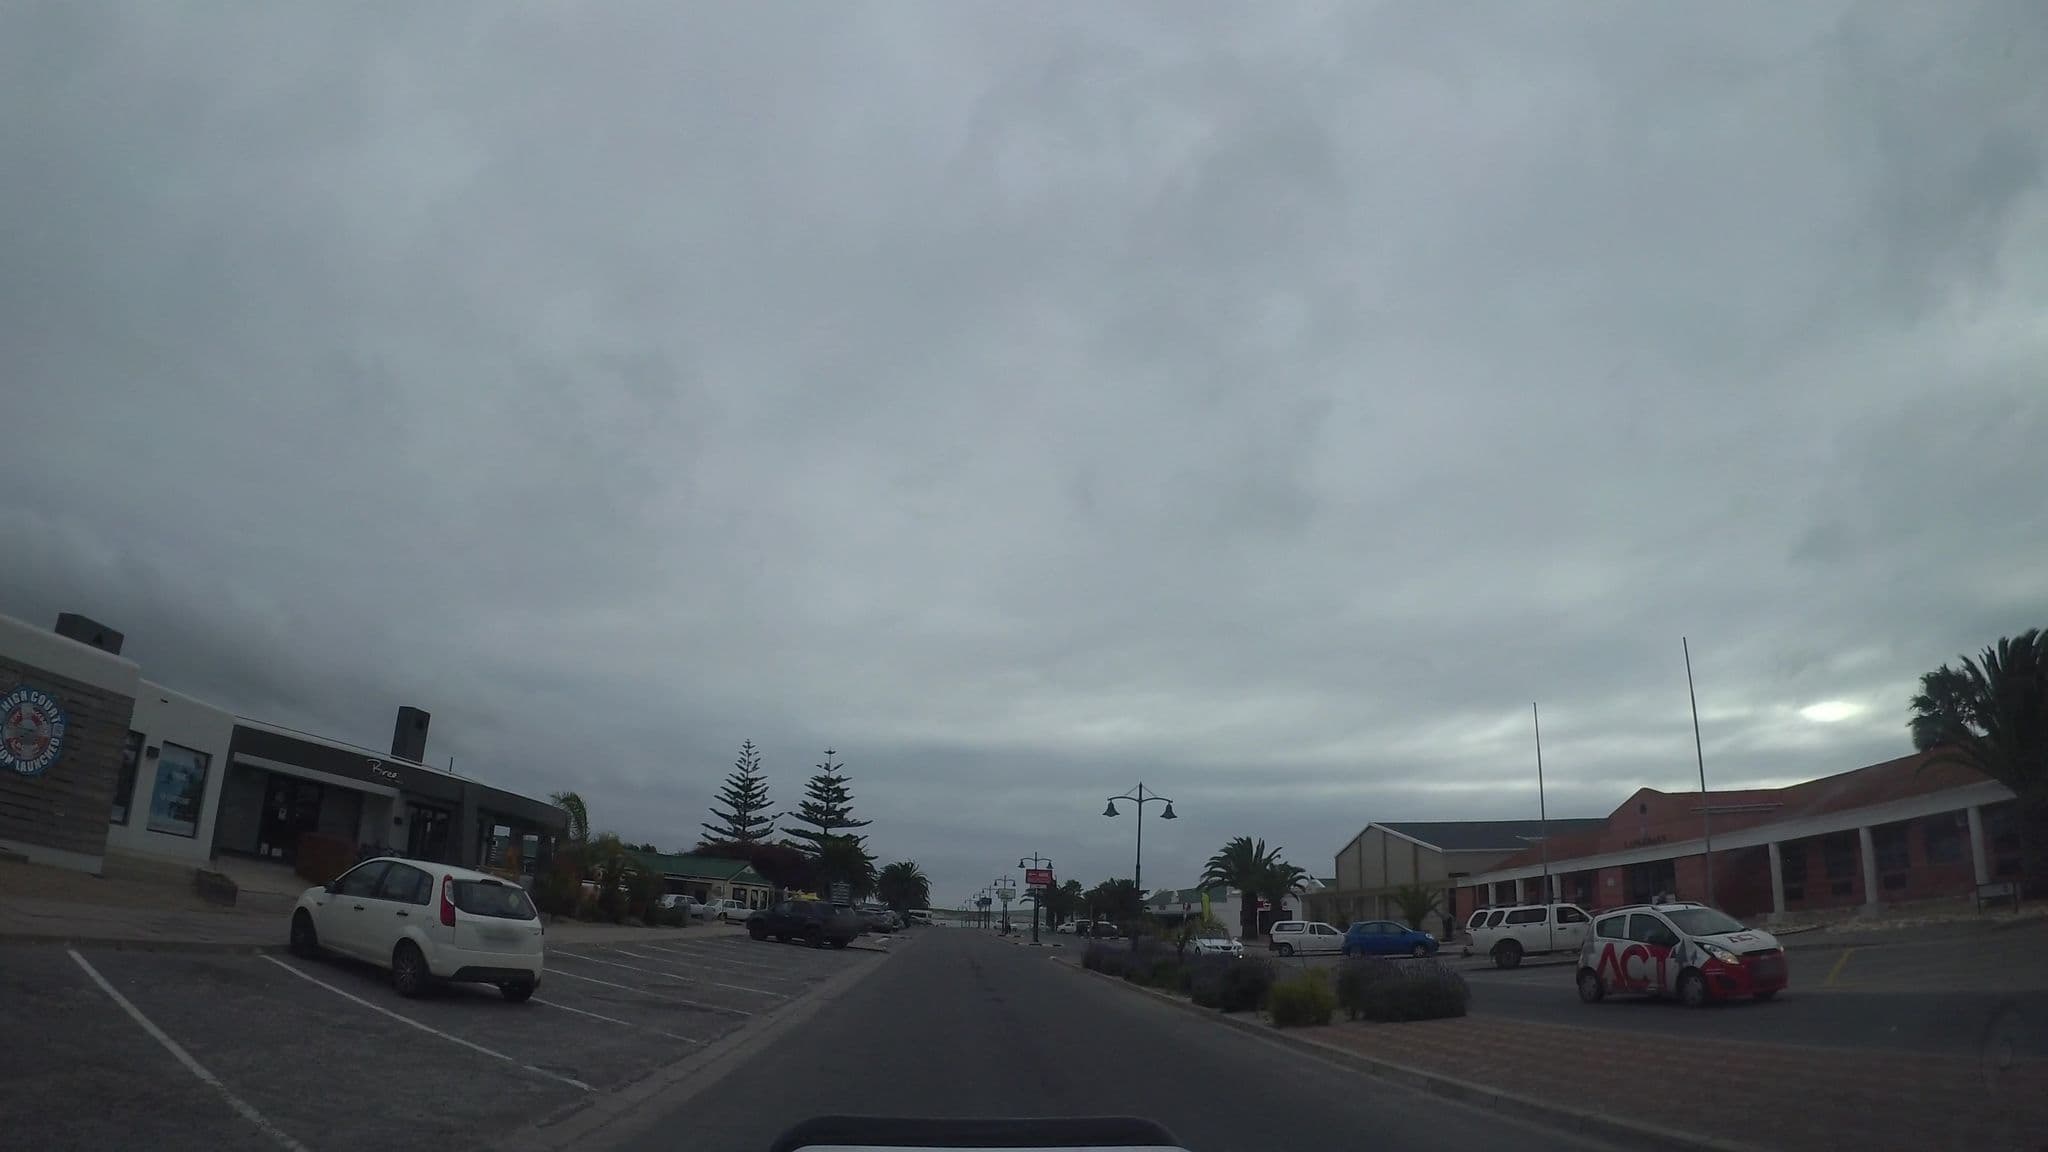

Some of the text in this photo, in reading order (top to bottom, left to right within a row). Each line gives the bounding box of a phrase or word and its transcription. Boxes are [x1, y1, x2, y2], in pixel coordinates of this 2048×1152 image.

[1, 690, 61, 724] HIGH COURT
[15, 737, 60, 772] LAUNCHED
[1726, 932, 1760, 944] ACT
[1597, 942, 1670, 991] ACT
